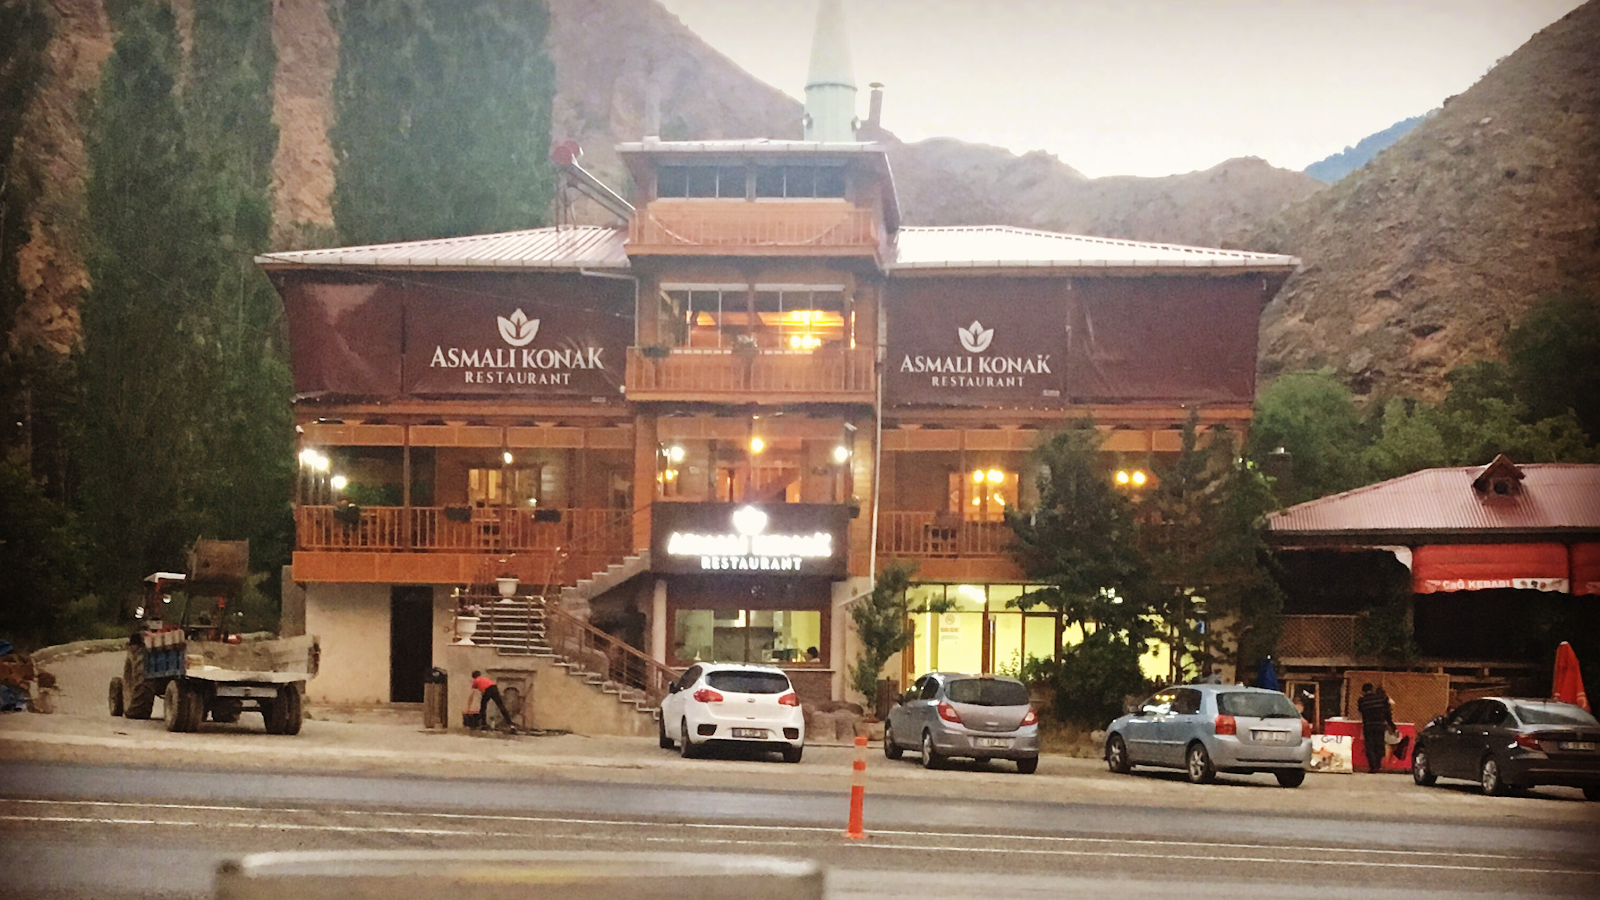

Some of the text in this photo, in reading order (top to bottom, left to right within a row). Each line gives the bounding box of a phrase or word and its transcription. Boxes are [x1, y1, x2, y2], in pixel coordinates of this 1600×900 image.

[430, 345, 605, 369] ASMALI KONAK
[900, 354, 1051, 374] ASMALI KONAK
[464, 371, 571, 385] RESTAURANT
[931, 376, 1025, 387] RESTAURANT
[700, 556, 803, 571] RESTAURANT
